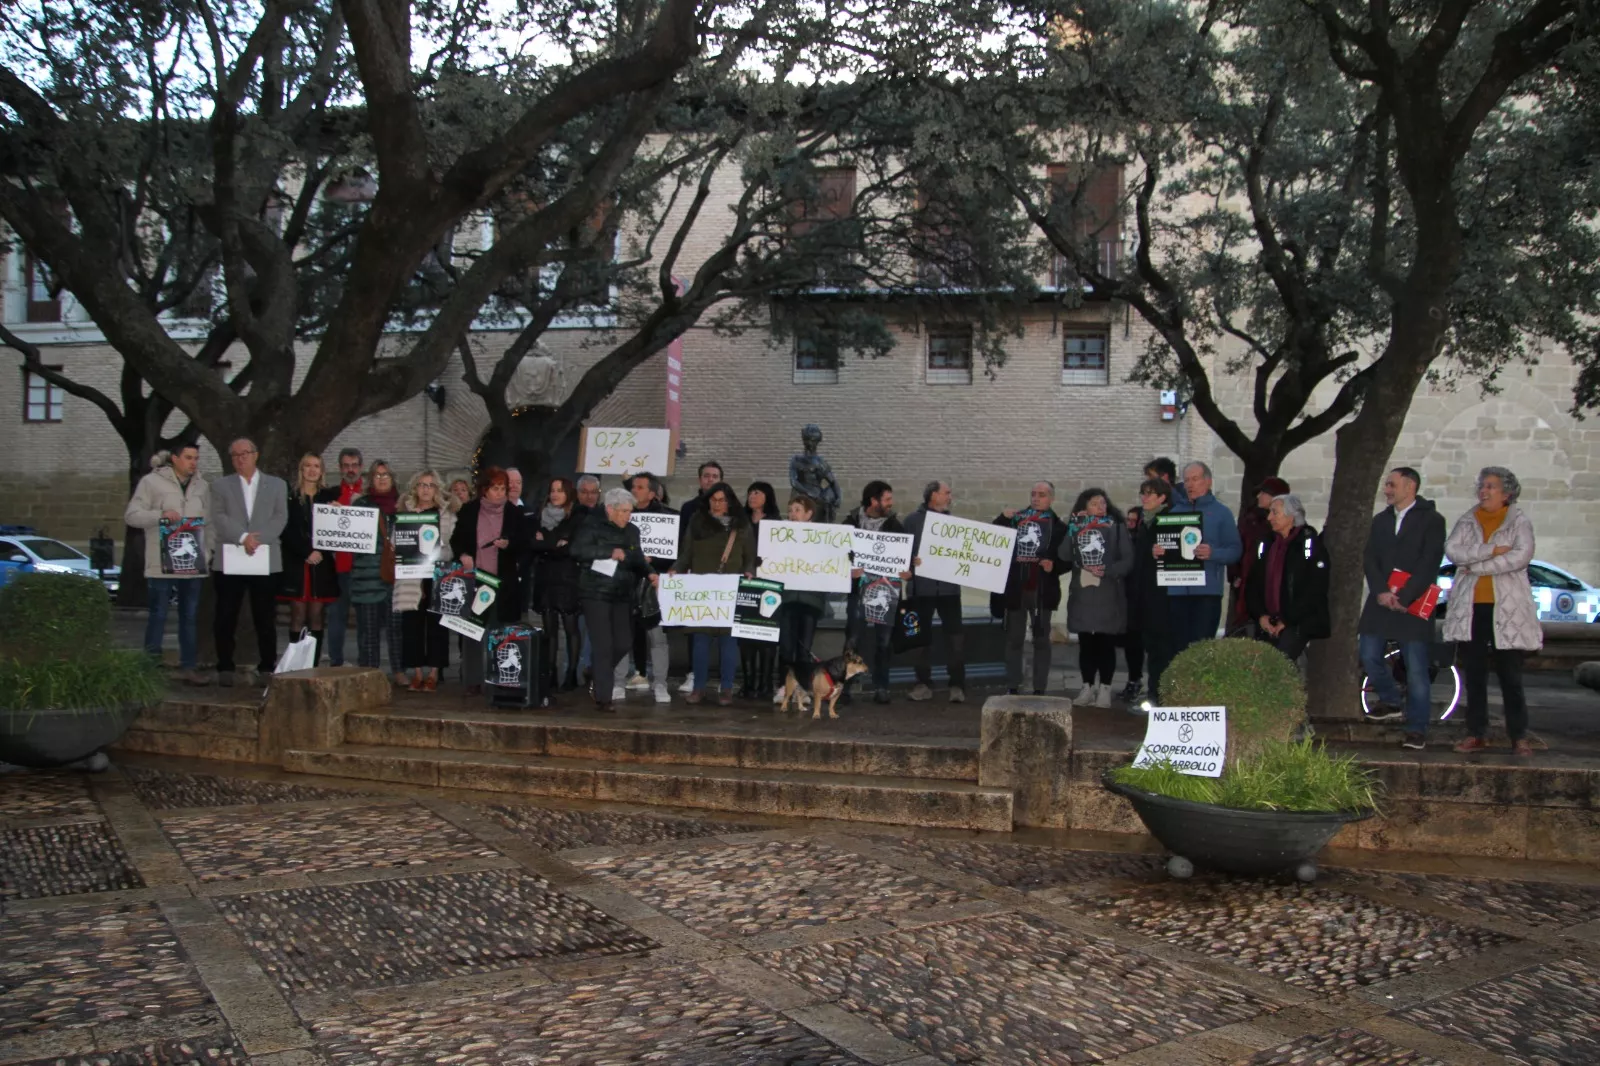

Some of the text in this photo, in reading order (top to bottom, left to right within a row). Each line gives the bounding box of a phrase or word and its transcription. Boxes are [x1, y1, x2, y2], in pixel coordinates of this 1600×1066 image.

[594, 431, 639, 450] 0,7%
[317, 507, 328, 515] NO
[340, 509, 375, 518] RECORTE
[641, 516, 675, 525] RECORTE
[316, 529, 373, 540] COOPERACIÓN
[770, 526, 797, 543] POR
[866, 532, 875, 541] AL
[876, 534, 910, 544] RECORTE
[962, 540, 974, 551] AL
[854, 552, 906, 565] OOPERACIÓN
[929, 545, 1001, 567] DESARROLLO
[954, 562, 971, 577] YA
[662, 578, 684, 590] LOS
[674, 590, 736, 602] RECORTES
[667, 605, 730, 622] MATAN
[1153, 711, 1221, 722] NO AL RECORTE
[1146, 743, 1220, 757] COOPERACIÓN
